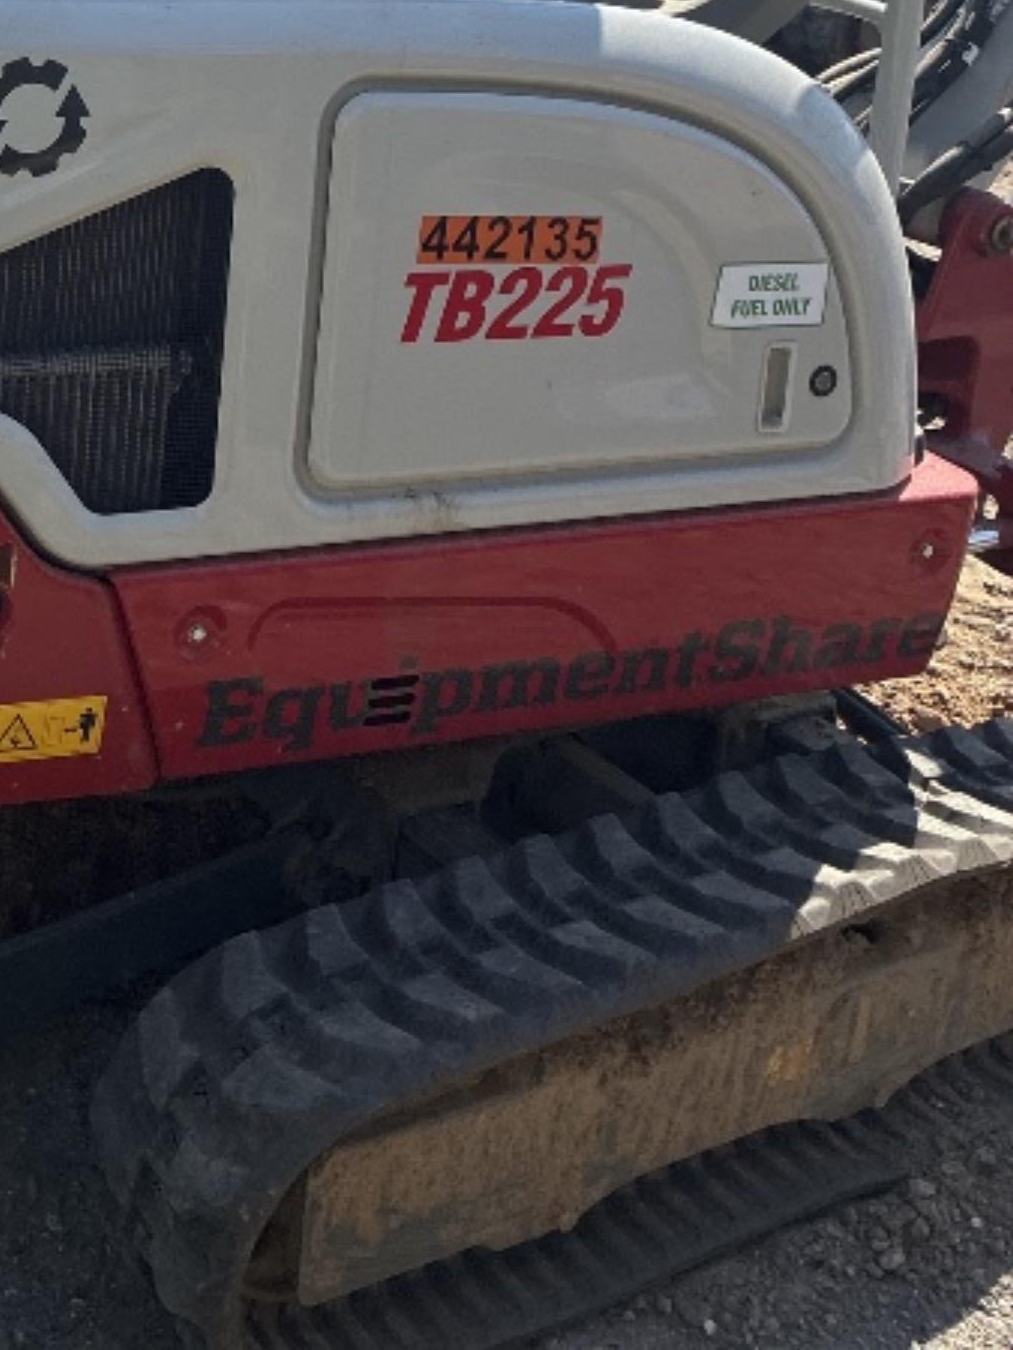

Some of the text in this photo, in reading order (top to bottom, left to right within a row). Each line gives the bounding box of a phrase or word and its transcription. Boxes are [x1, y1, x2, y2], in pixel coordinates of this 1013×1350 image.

[421, 216, 601, 261] 442135
[401, 264, 633, 342] TB225
[748, 272, 800, 292] DIESEL
[731, 297, 812, 319] FUEL ONLY
[194, 612, 945, 751] EquipmentShare
